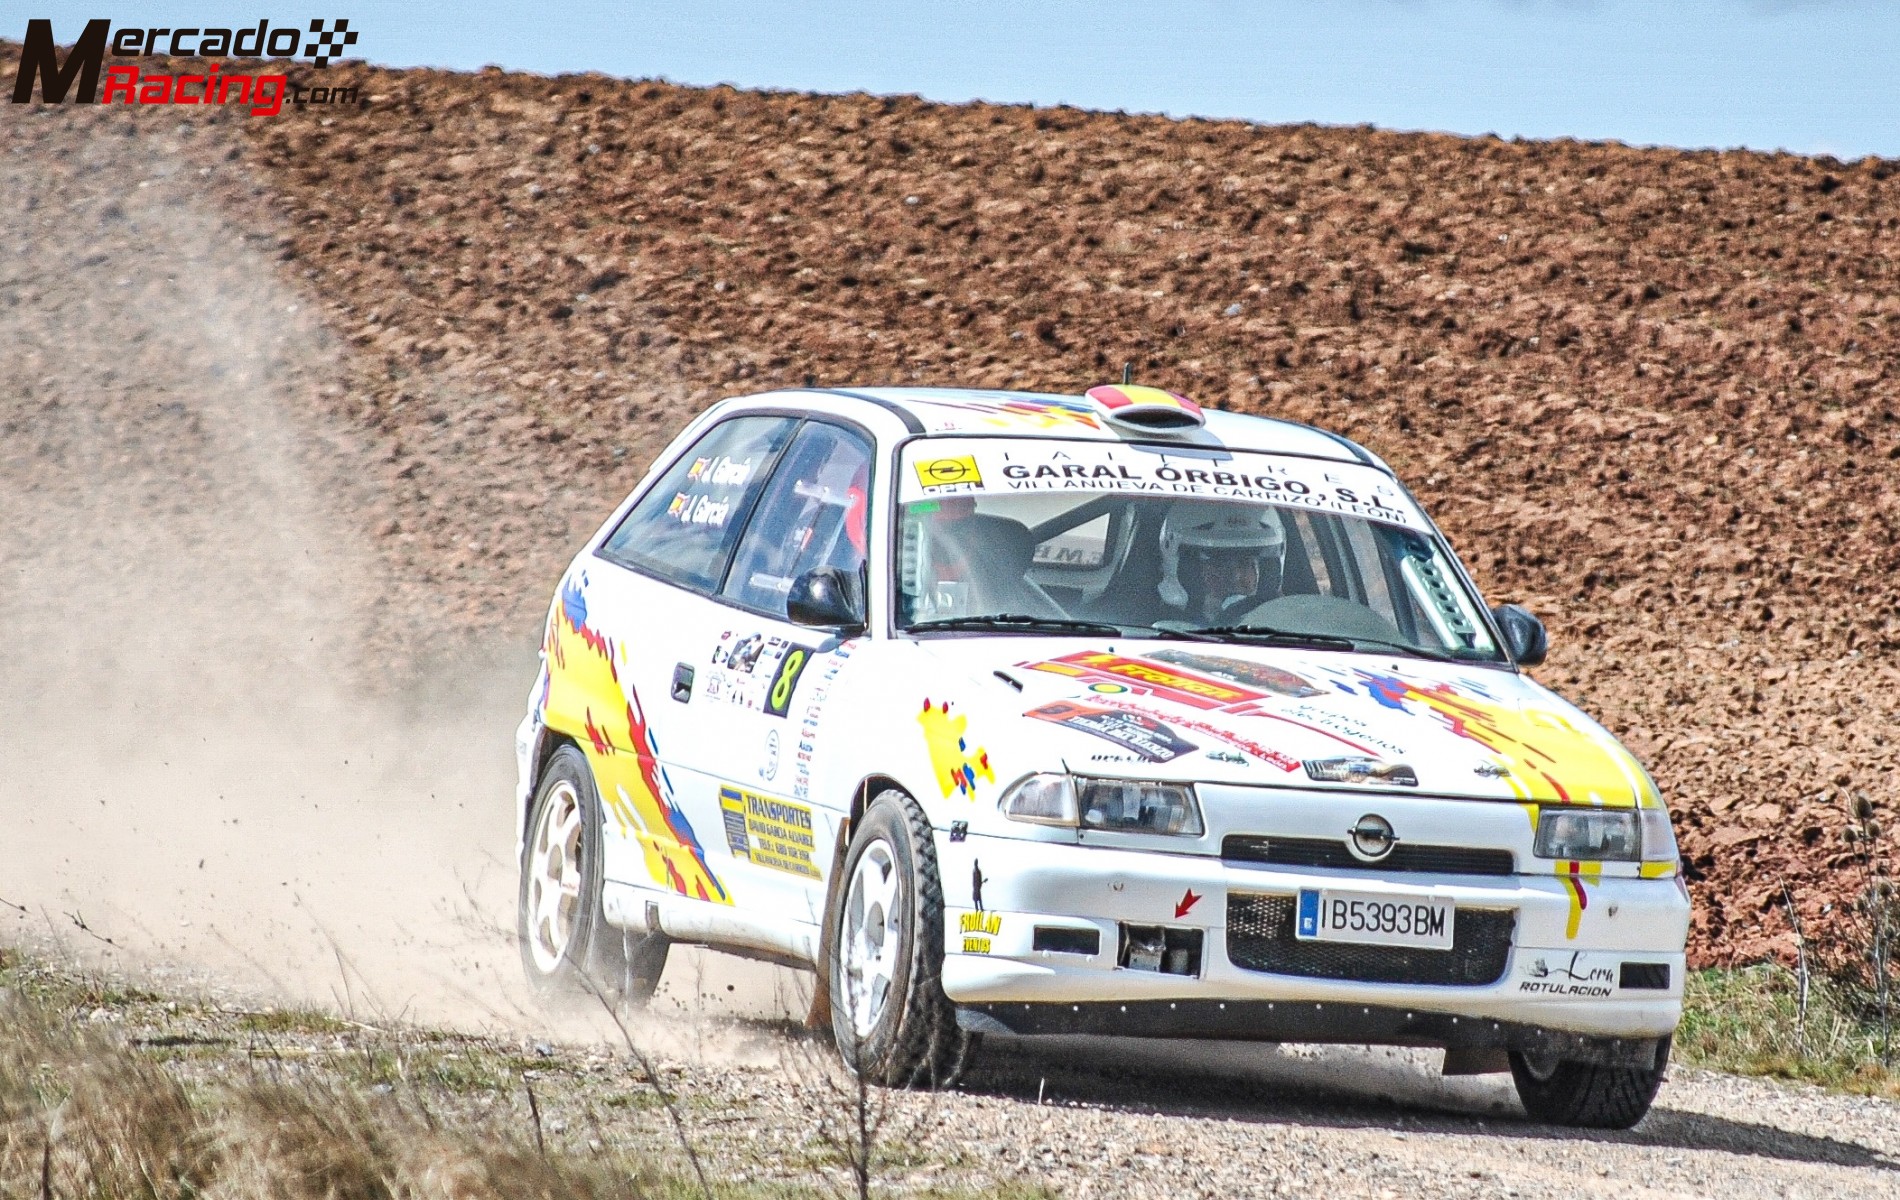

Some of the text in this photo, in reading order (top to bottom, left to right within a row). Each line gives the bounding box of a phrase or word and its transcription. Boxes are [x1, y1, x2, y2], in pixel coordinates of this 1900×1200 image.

[1002, 464, 1142, 480] GARAL
[1007, 480, 1164, 492] VILLANUEVA
[1173, 483, 1203, 494] DE
[1214, 485, 1321, 507] CARRIZO
[771, 650, 804, 710] 8
[747, 795, 811, 829] TRANSPORTES
[1519, 981, 1613, 997] ROTULACION
